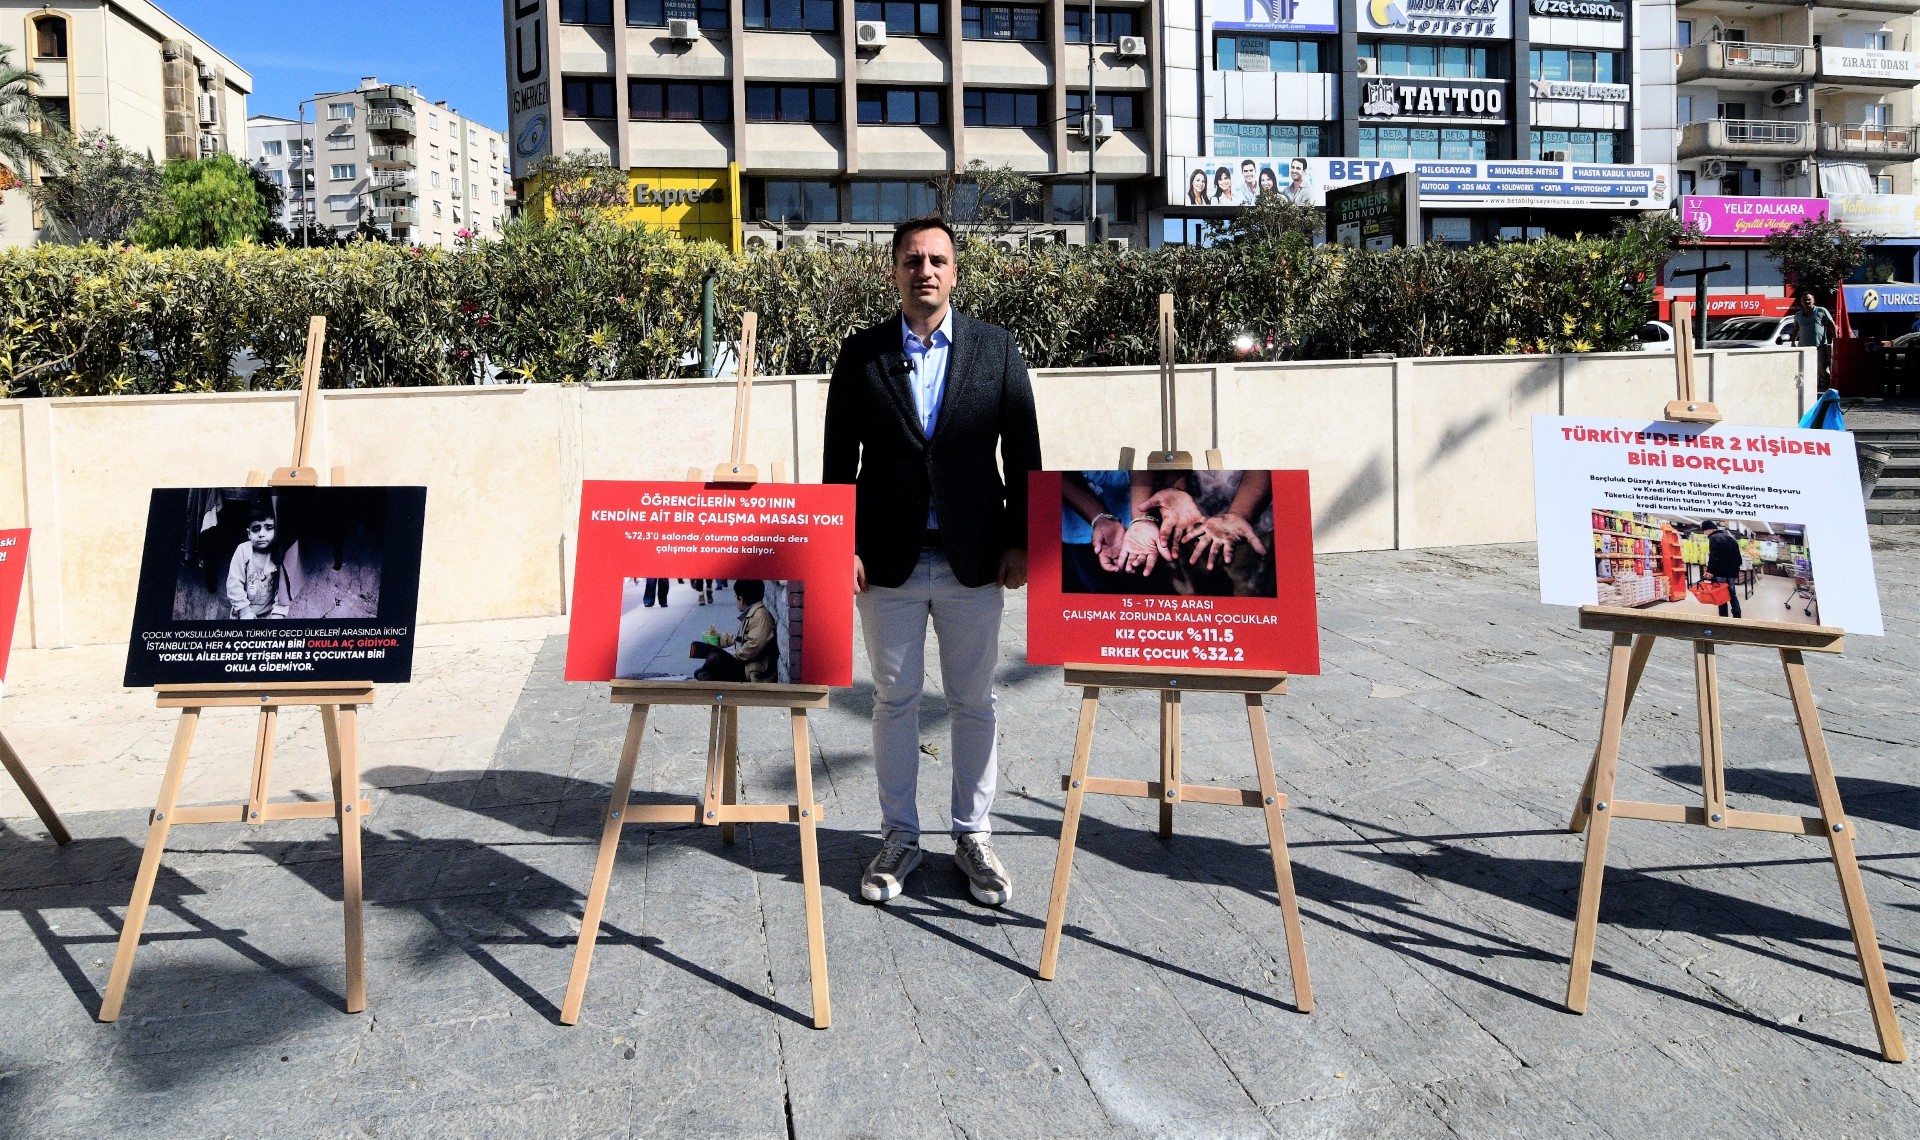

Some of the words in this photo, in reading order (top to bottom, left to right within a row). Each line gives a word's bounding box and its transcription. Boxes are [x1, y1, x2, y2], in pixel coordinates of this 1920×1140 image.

[1409, 0, 1462, 10] MURAT
[1470, 0, 1498, 14] ÇAY
[1881, 59, 1909, 70] ODASI
[1400, 86, 1501, 112] TATTOO
[1243, 126, 1263, 135] BETA
[1275, 127, 1294, 136] BETA
[1304, 127, 1320, 136] BET
[1415, 130, 1434, 138] BETA
[1330, 161, 1395, 180] BETA
[637, 184, 724, 208] Express
[1342, 192, 1388, 212] SIEMENS
[1343, 205, 1388, 221] BORNOVA
[1724, 201, 1753, 214] YELİZ
[1756, 204, 1804, 214] DALKARA
[1740, 301, 1759, 309] 1959
[1882, 294, 1920, 305] TURKCE
[1561, 426, 1682, 447] TÜRKİYE'DE
[1685, 434, 1724, 449] HER
[1729, 437, 1742, 450] 2
[1747, 435, 1832, 456] KİŞİDEN
[1628, 449, 1666, 467] BİRİ
[1672, 453, 1764, 474] BORÇLU!
[1590, 475, 1626, 484] Borçluluk
[1627, 476, 1654, 486] Düzeyi
[1656, 479, 1687, 488] Arttıkça
[1689, 481, 1720, 489] Tüketici
[1722, 483, 1766, 493] Kredilerine
[1767, 486, 1801, 496] Başvuru
[641, 492, 736, 507] ÖĞRENCİLERİN
[740, 497, 795, 508] %90'ININ
[1644, 486, 1665, 494] Kredi
[1666, 487, 1686, 495] Kartı
[1687, 489, 1724, 497] Kullanımı
[1726, 491, 1757, 501] Artıyor!
[1604, 492, 1635, 500] Tüketici
[1636, 493, 1681, 503] kredilerinin
[1682, 496, 1706, 504] tutarı
[1712, 498, 1733, 506] yılda
[1753, 502, 1789, 510] artarken
[1679, 505, 1716, 513] kullanımı
[591, 508, 646, 522] KENDİNE
[650, 509, 669, 522] AİT
[674, 509, 694, 523] BİR
[698, 512, 756, 526] ÇALIŞMA
[759, 514, 809, 525] MASASI
[812, 514, 844, 526] YOK!
[0, 537, 17, 547] ski
[741, 534, 785, 543] odasında
[788, 534, 808, 543] ders
[656, 544, 698, 554] çalışmak
[700, 545, 738, 554] zorunda
[741, 545, 775, 555] kalıyor.
[1122, 599, 1133, 607] 15
[1144, 599, 1155, 608] 17
[1158, 599, 1177, 611] YAŞ
[1181, 600, 1214, 610] ARASI
[1063, 610, 1116, 622] ÇALIŞMAK
[1119, 612, 1172, 622] ZORUNDA
[1175, 613, 1212, 623] KALAN
[1215, 614, 1278, 625] ÇOCUKLAR
[142, 631, 172, 640] ÇOCUK
[174, 628, 243, 638] YOKSULLUĞUNDA
[246, 628, 277, 637] TÜRKİYE
[279, 629, 302, 637] OECD
[305, 627, 340, 636] ÜLKELERİ
[342, 628, 381, 636] ARASINDA
[384, 626, 407, 636] İKİNCİ
[1115, 628, 1135, 639] KIZ
[1138, 629, 1184, 643] ÇOCUK
[1187, 628, 1234, 642] %11.5
[146, 641, 203, 650] İSTANBUL'DA
[205, 641, 223, 649] HER
[225, 641, 232, 649] 4
[234, 640, 285, 651] ÇOCUKTAN
[287, 638, 305, 648] BİRİ
[307, 639, 339, 648] OKULA
[341, 639, 355, 649] AÇ
[357, 637, 400, 647] GİDİYOR.
[158, 652, 194, 661] YOKSUL
[196, 650, 243, 661] AİLELERDE
[246, 650, 282, 661] YETİŞEN
[285, 650, 302, 660] HER
[304, 650, 310, 659] 3
[313, 650, 365, 661] ÇOCUKTAN
[367, 648, 385, 659] BİRİ
[1100, 646, 1140, 658] ERKEK
[1142, 648, 1189, 661] ÇOCUK
[1192, 646, 1244, 662] %32.2
[224, 663, 257, 672] OKULA
[259, 661, 314, 672] GİDEMİYOR.
